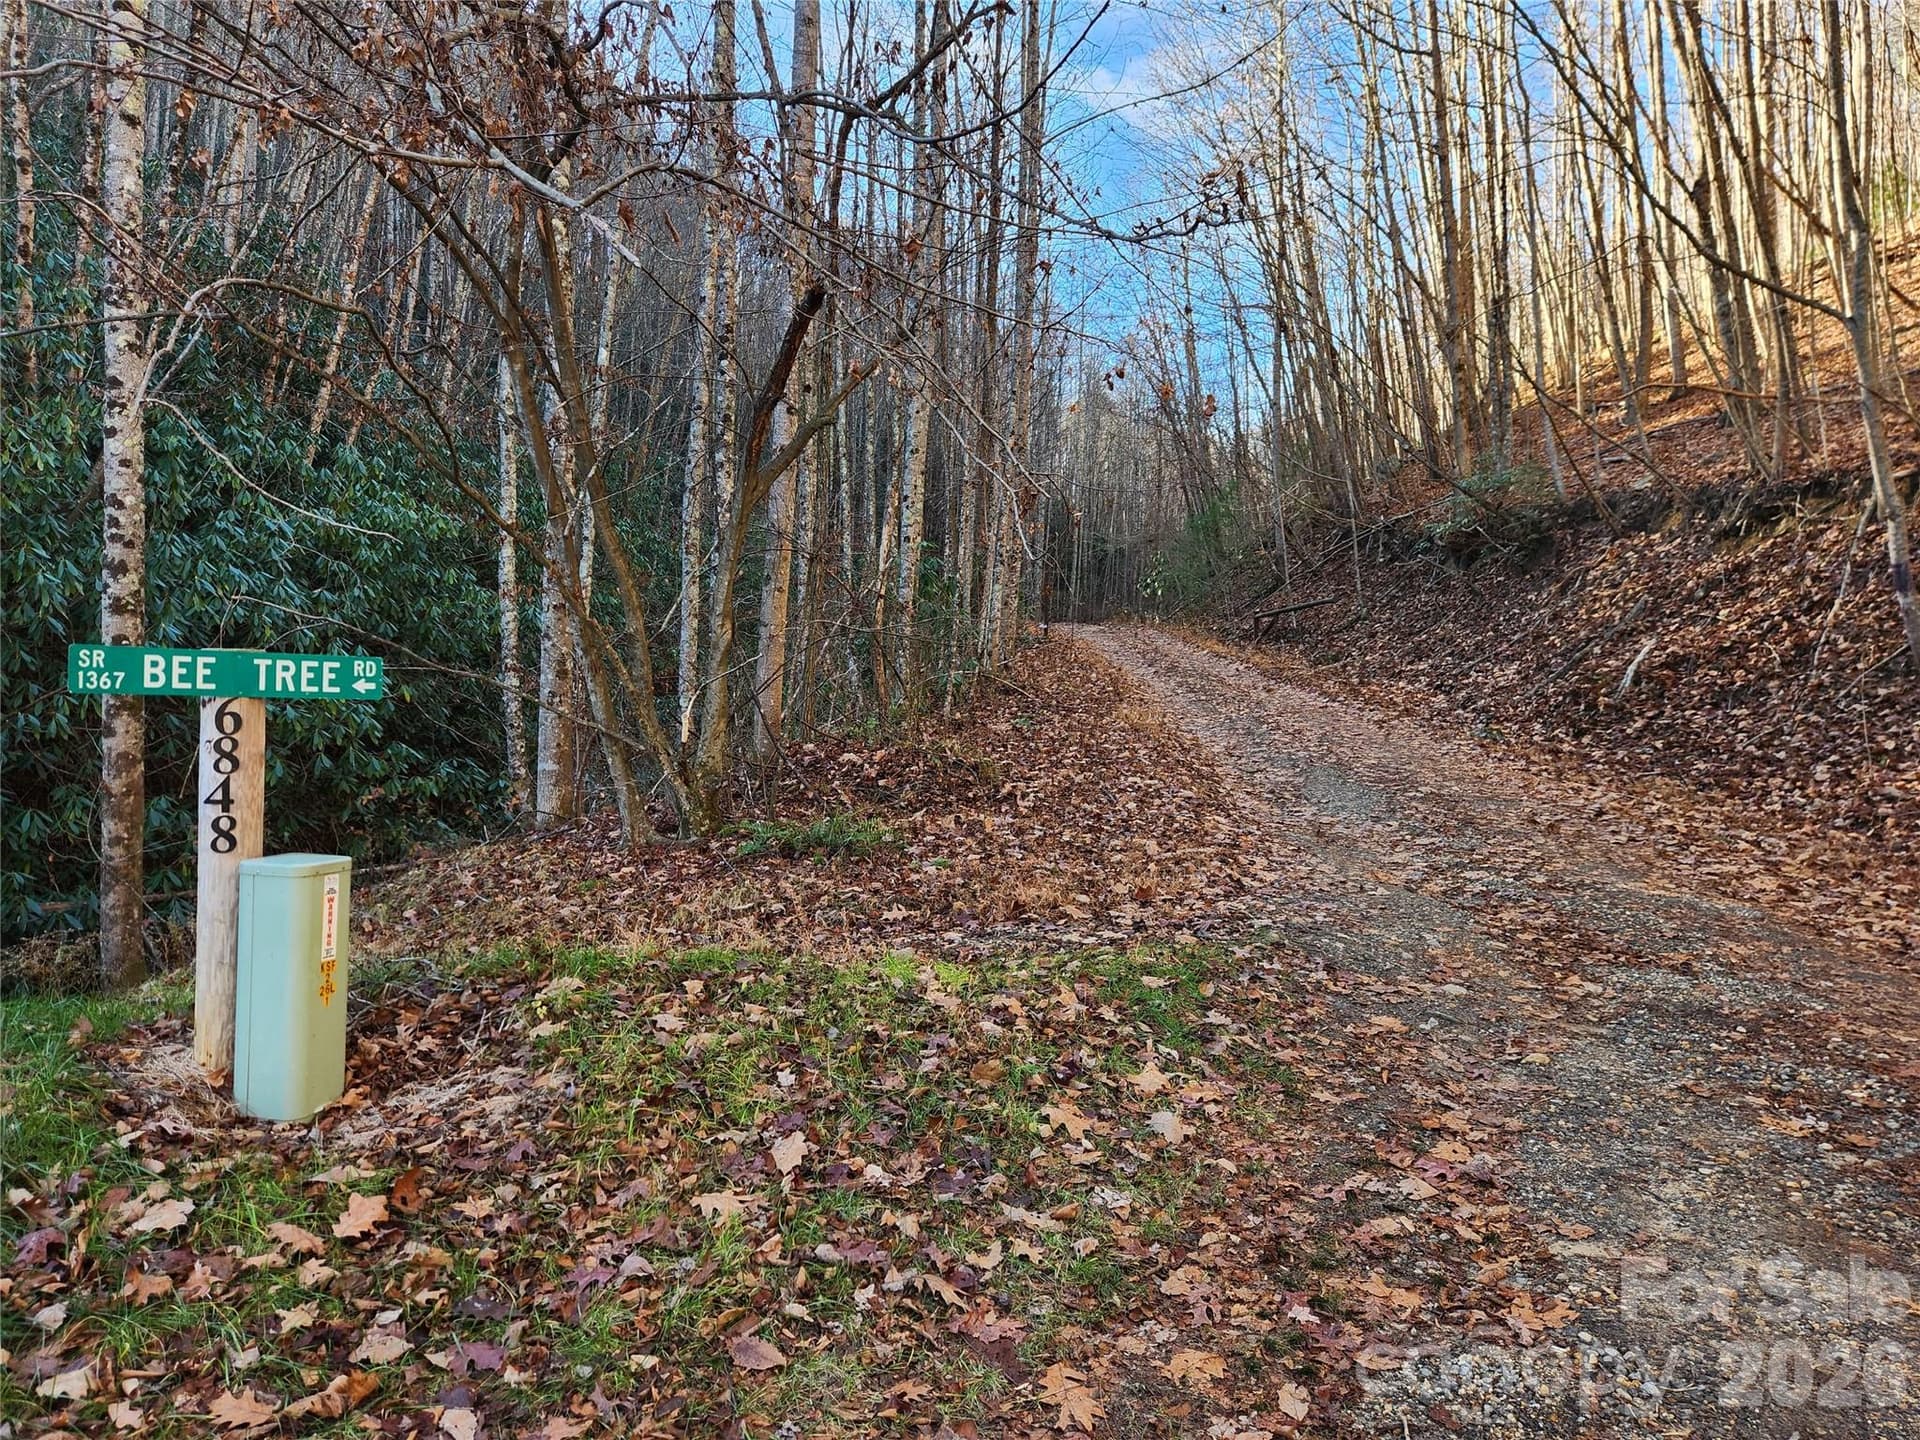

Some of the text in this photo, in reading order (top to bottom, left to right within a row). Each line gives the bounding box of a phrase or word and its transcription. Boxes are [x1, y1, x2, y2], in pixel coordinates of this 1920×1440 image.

[78, 649, 105, 668] SR
[78, 671, 125, 690] 1367
[143, 654, 377, 693] BEE TREE RD
[203, 697, 243, 854] 6848
